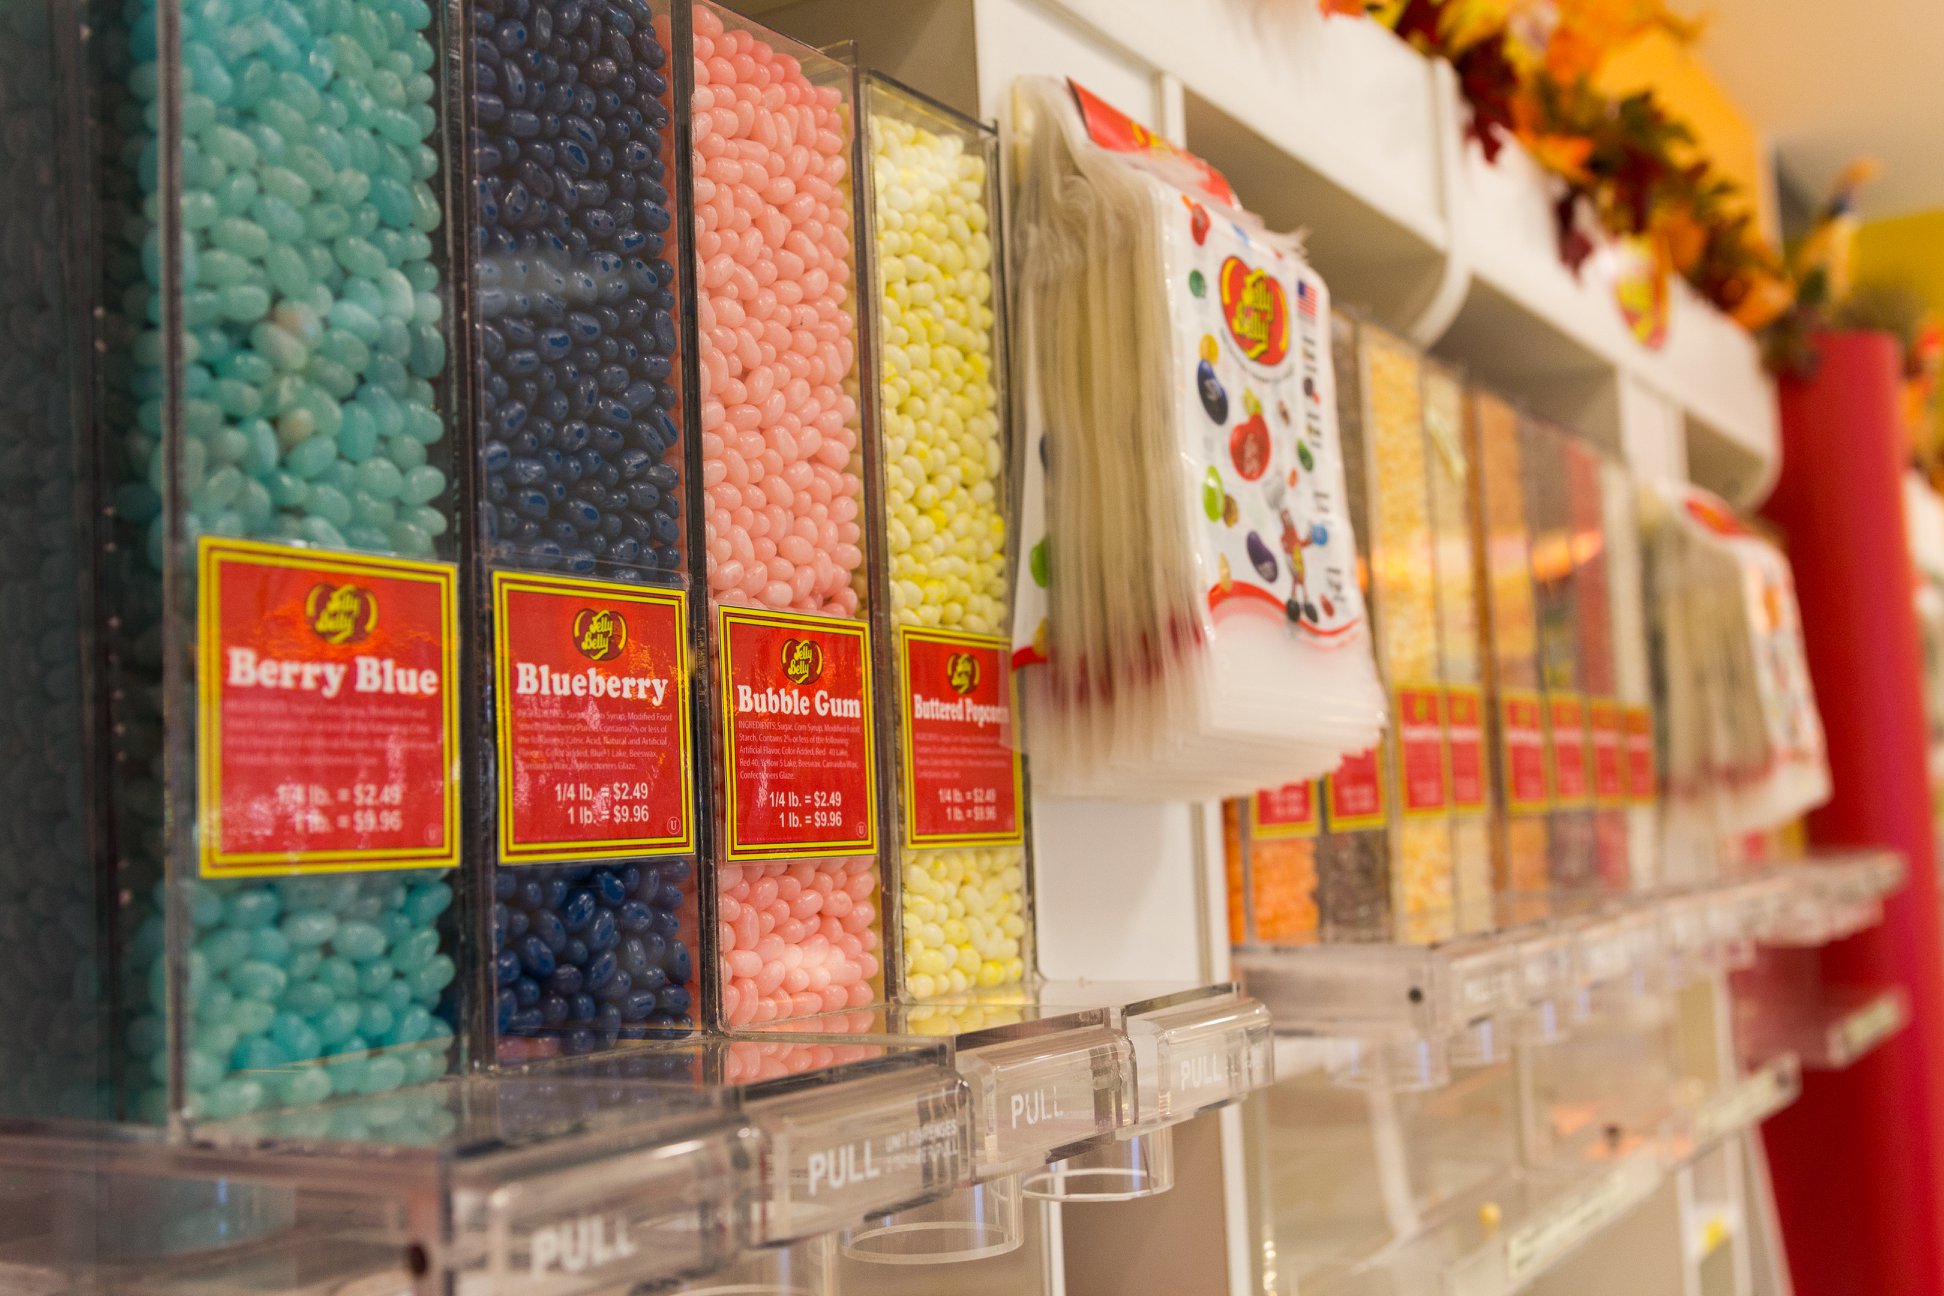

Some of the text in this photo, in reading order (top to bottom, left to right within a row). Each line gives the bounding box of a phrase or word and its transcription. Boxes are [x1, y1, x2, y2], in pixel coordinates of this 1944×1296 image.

[1241, 268, 1273, 323] Jelly
[1231, 300, 1268, 358] Belly
[589, 609, 613, 637] Jelly
[581, 631, 609, 659] Belly
[794, 640, 812, 663] Jelly
[228, 647, 438, 698] Berry Blue
[788, 659, 809, 684] Belly
[516, 663, 668, 706] Blueberry
[737, 684, 861, 718] Bubble Gum
[914, 694, 963, 721] Buttered
[606, 712, 626, 722] Syrup,
[628, 712, 655, 721] Modified
[657, 713, 672, 722] Food
[648, 725, 660, 733] less
[739, 720, 776, 729] INGREDIENTS:
[778, 722, 794, 732] Sugar,
[628, 737, 641, 745] and
[642, 737, 667, 746] Artificial
[740, 745, 762, 754] Artificial
[759, 734, 782, 743] Contains
[630, 749, 658, 759] Beeswax,
[740, 758, 750, 767] Red
[554, 782, 575, 801] 1/4
[579, 782, 597, 801] lb.
[613, 782, 648, 800] $2.49
[769, 792, 787, 808] 1/4
[788, 792, 802, 808] lb.
[814, 791, 842, 807] $2.49
[568, 807, 575, 825] 1
[579, 807, 598, 825] lb.
[613, 805, 649, 823] $9.96
[779, 813, 785, 827] 1
[789, 812, 802, 828] lb.
[814, 811, 842, 827] $9.96
[1181, 1053, 1222, 1090] PULL
[1011, 1086, 1064, 1129] PULL
[808, 1140, 880, 1197] PULL
[530, 1214, 637, 1280] PULL
